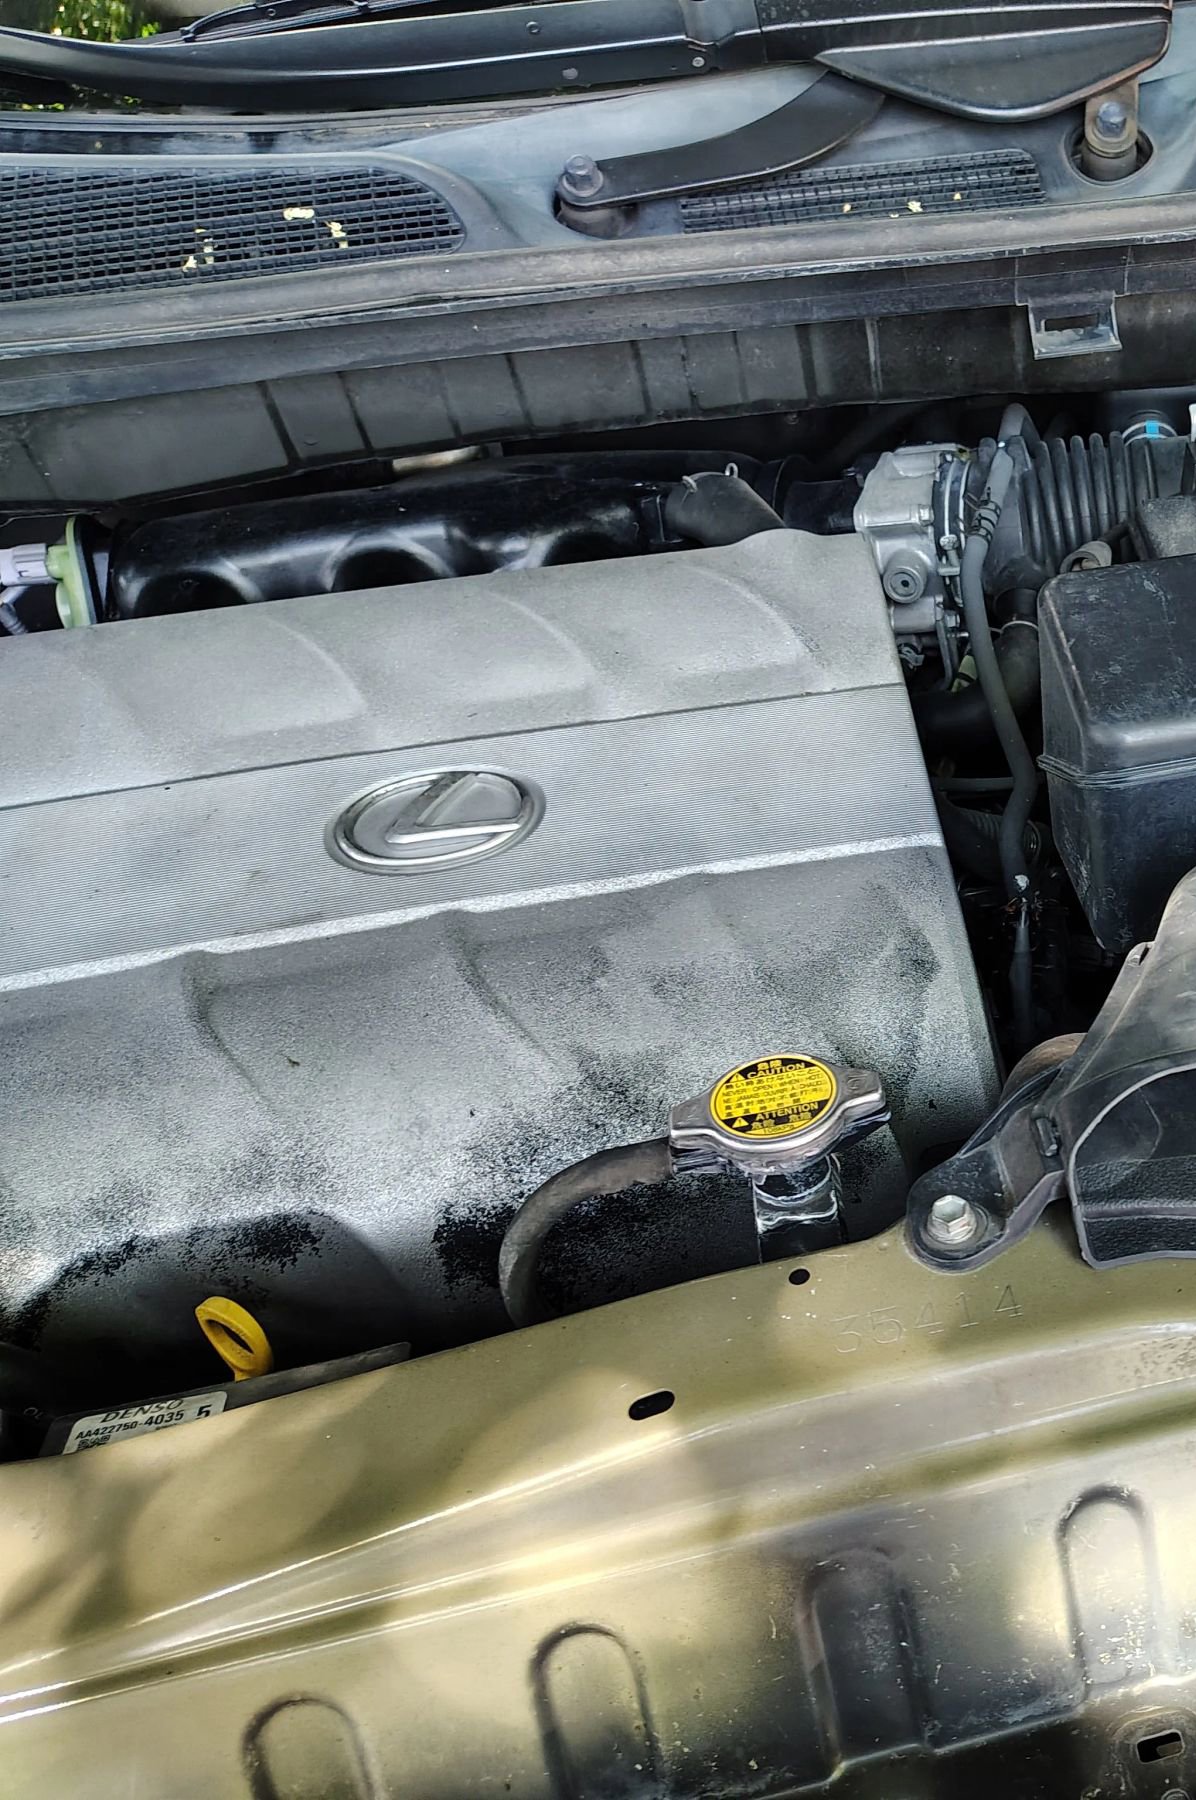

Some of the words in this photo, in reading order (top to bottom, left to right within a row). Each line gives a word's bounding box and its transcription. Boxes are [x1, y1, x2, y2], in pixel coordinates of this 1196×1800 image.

[747, 1062, 806, 1079] CAUTION
[722, 1088, 747, 1097] NEVER
[753, 1083, 773, 1092] OPEN
[779, 1078, 800, 1087] WHEN
[736, 1093, 762, 1102] JAMAIS
[756, 1101, 819, 1121] ATTENTION
[831, 1283, 1024, 1352] 35414
[101, 1398, 185, 1423] DENSO
[74, 1410, 184, 1441] AA422750-4035
